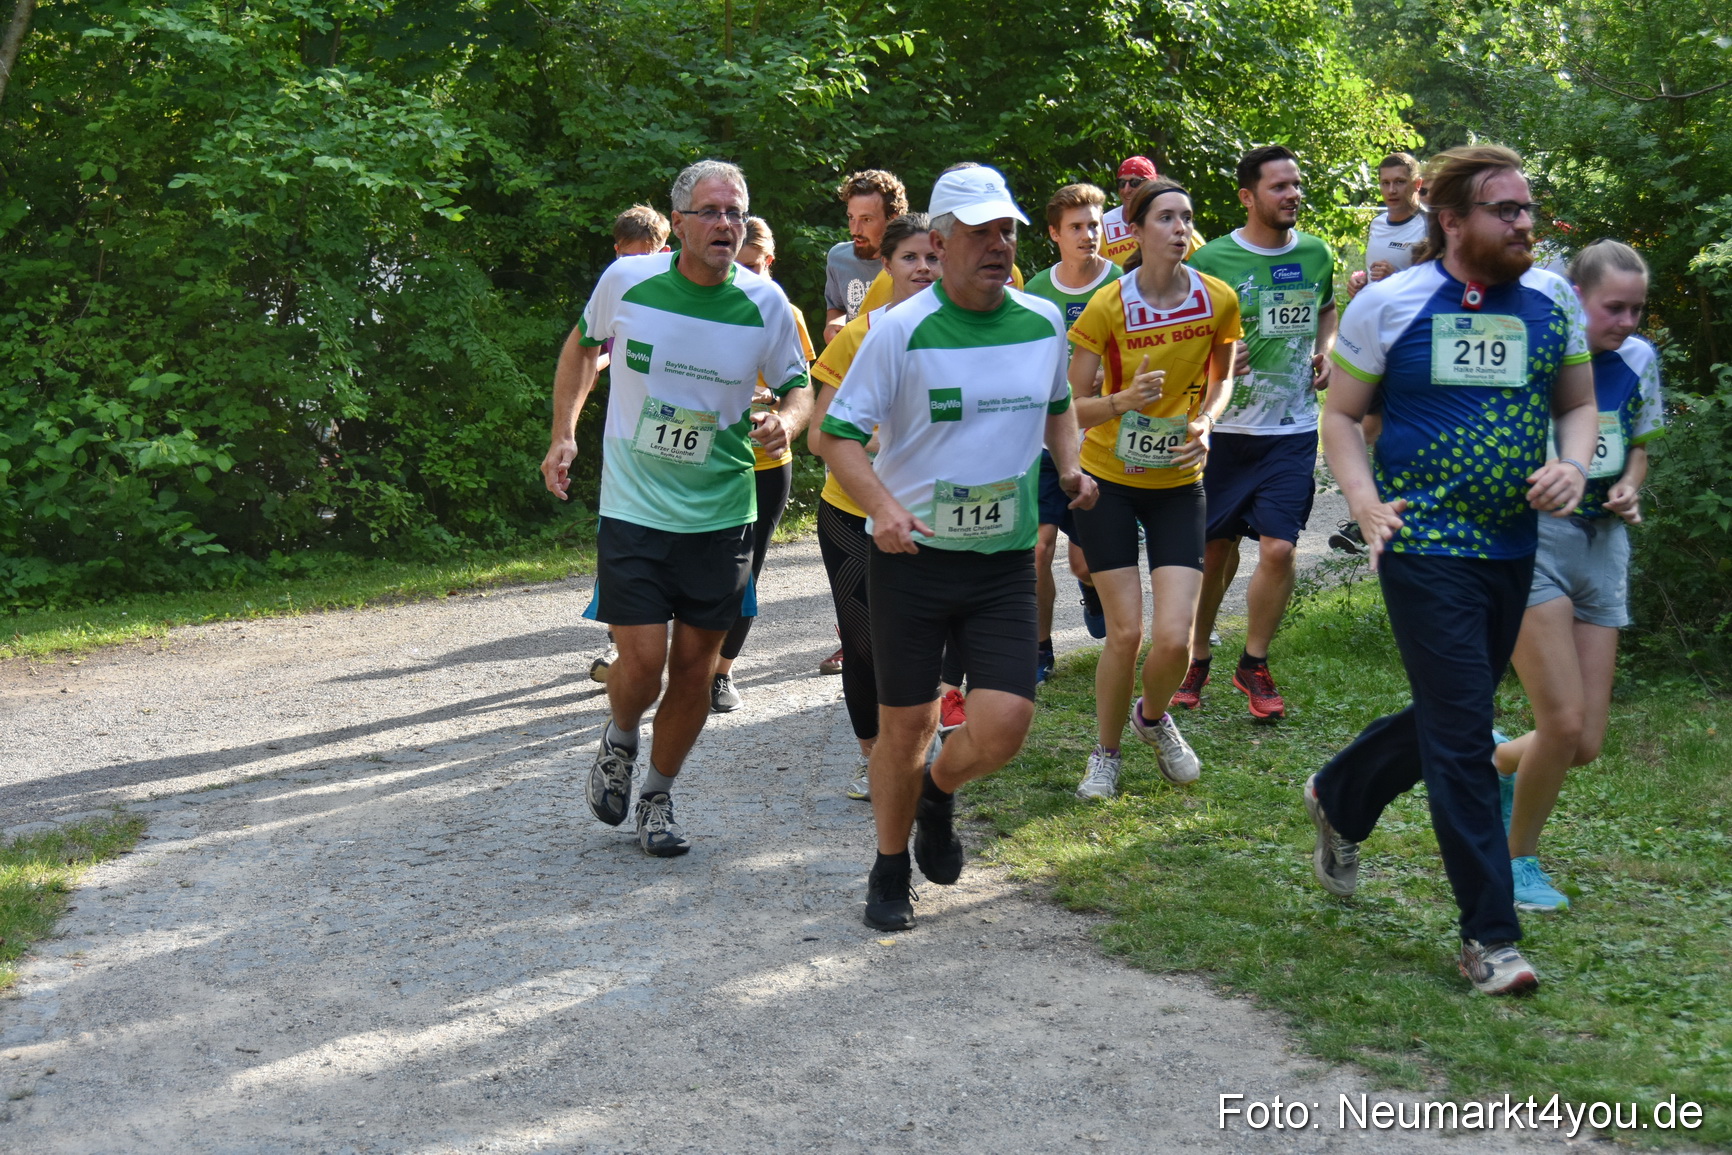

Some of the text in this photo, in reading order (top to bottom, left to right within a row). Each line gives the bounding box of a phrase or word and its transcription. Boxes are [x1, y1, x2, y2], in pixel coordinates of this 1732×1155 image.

[1107, 241, 1136, 257] MAX
[1268, 306, 1311, 324] 1622
[1126, 324, 1214, 350] MAX BÖGL
[626, 348, 650, 362] BayWa
[1453, 340, 1506, 366] 219
[664, 367, 685, 376] Immer
[696, 374, 714, 382] gutes
[665, 360, 719, 376] BayWa Baustoffe
[1475, 366, 1506, 374] Raimund
[930, 399, 961, 411] BayWa
[978, 396, 1032, 407] BayWa Baustoffe
[1012, 404, 1029, 412] gutes
[655, 424, 699, 451] 116
[1127, 431, 1179, 454] 1649
[650, 443, 695, 457] Lerzer Günther
[952, 502, 1001, 526] 114
[972, 523, 1003, 531] Christian
